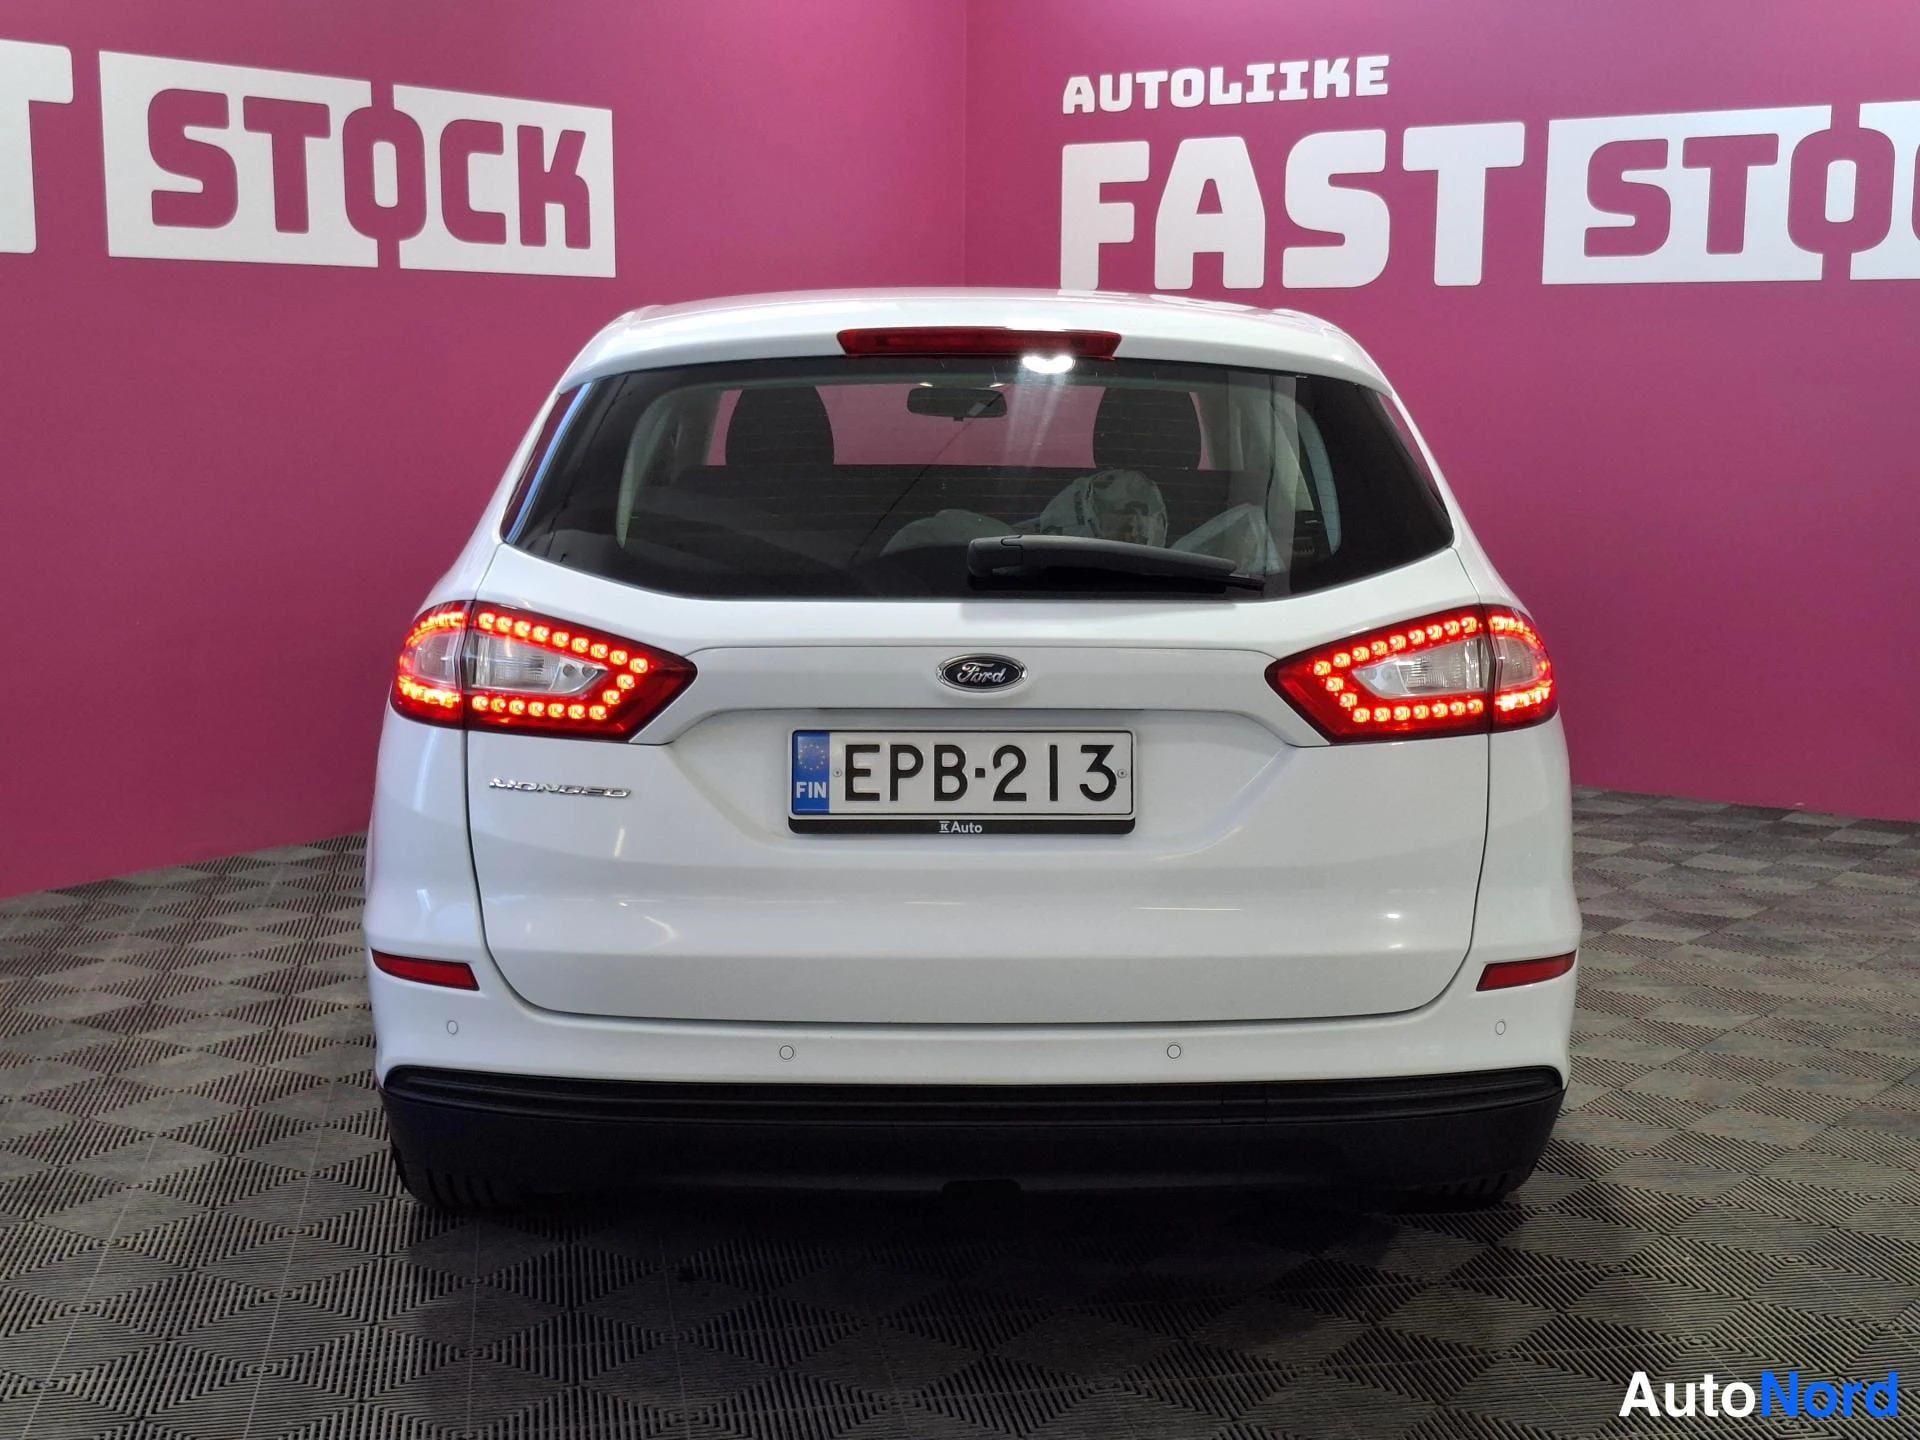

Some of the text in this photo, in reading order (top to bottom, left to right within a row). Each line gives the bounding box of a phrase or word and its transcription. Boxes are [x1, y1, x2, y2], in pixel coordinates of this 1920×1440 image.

[1062, 55, 1390, 115] AUTOLIIKE
[147, 88, 591, 250] STOCK
[1060, 121, 1920, 290] FAST STO
[957, 662, 1007, 683] Ford
[796, 782, 827, 799] FIN
